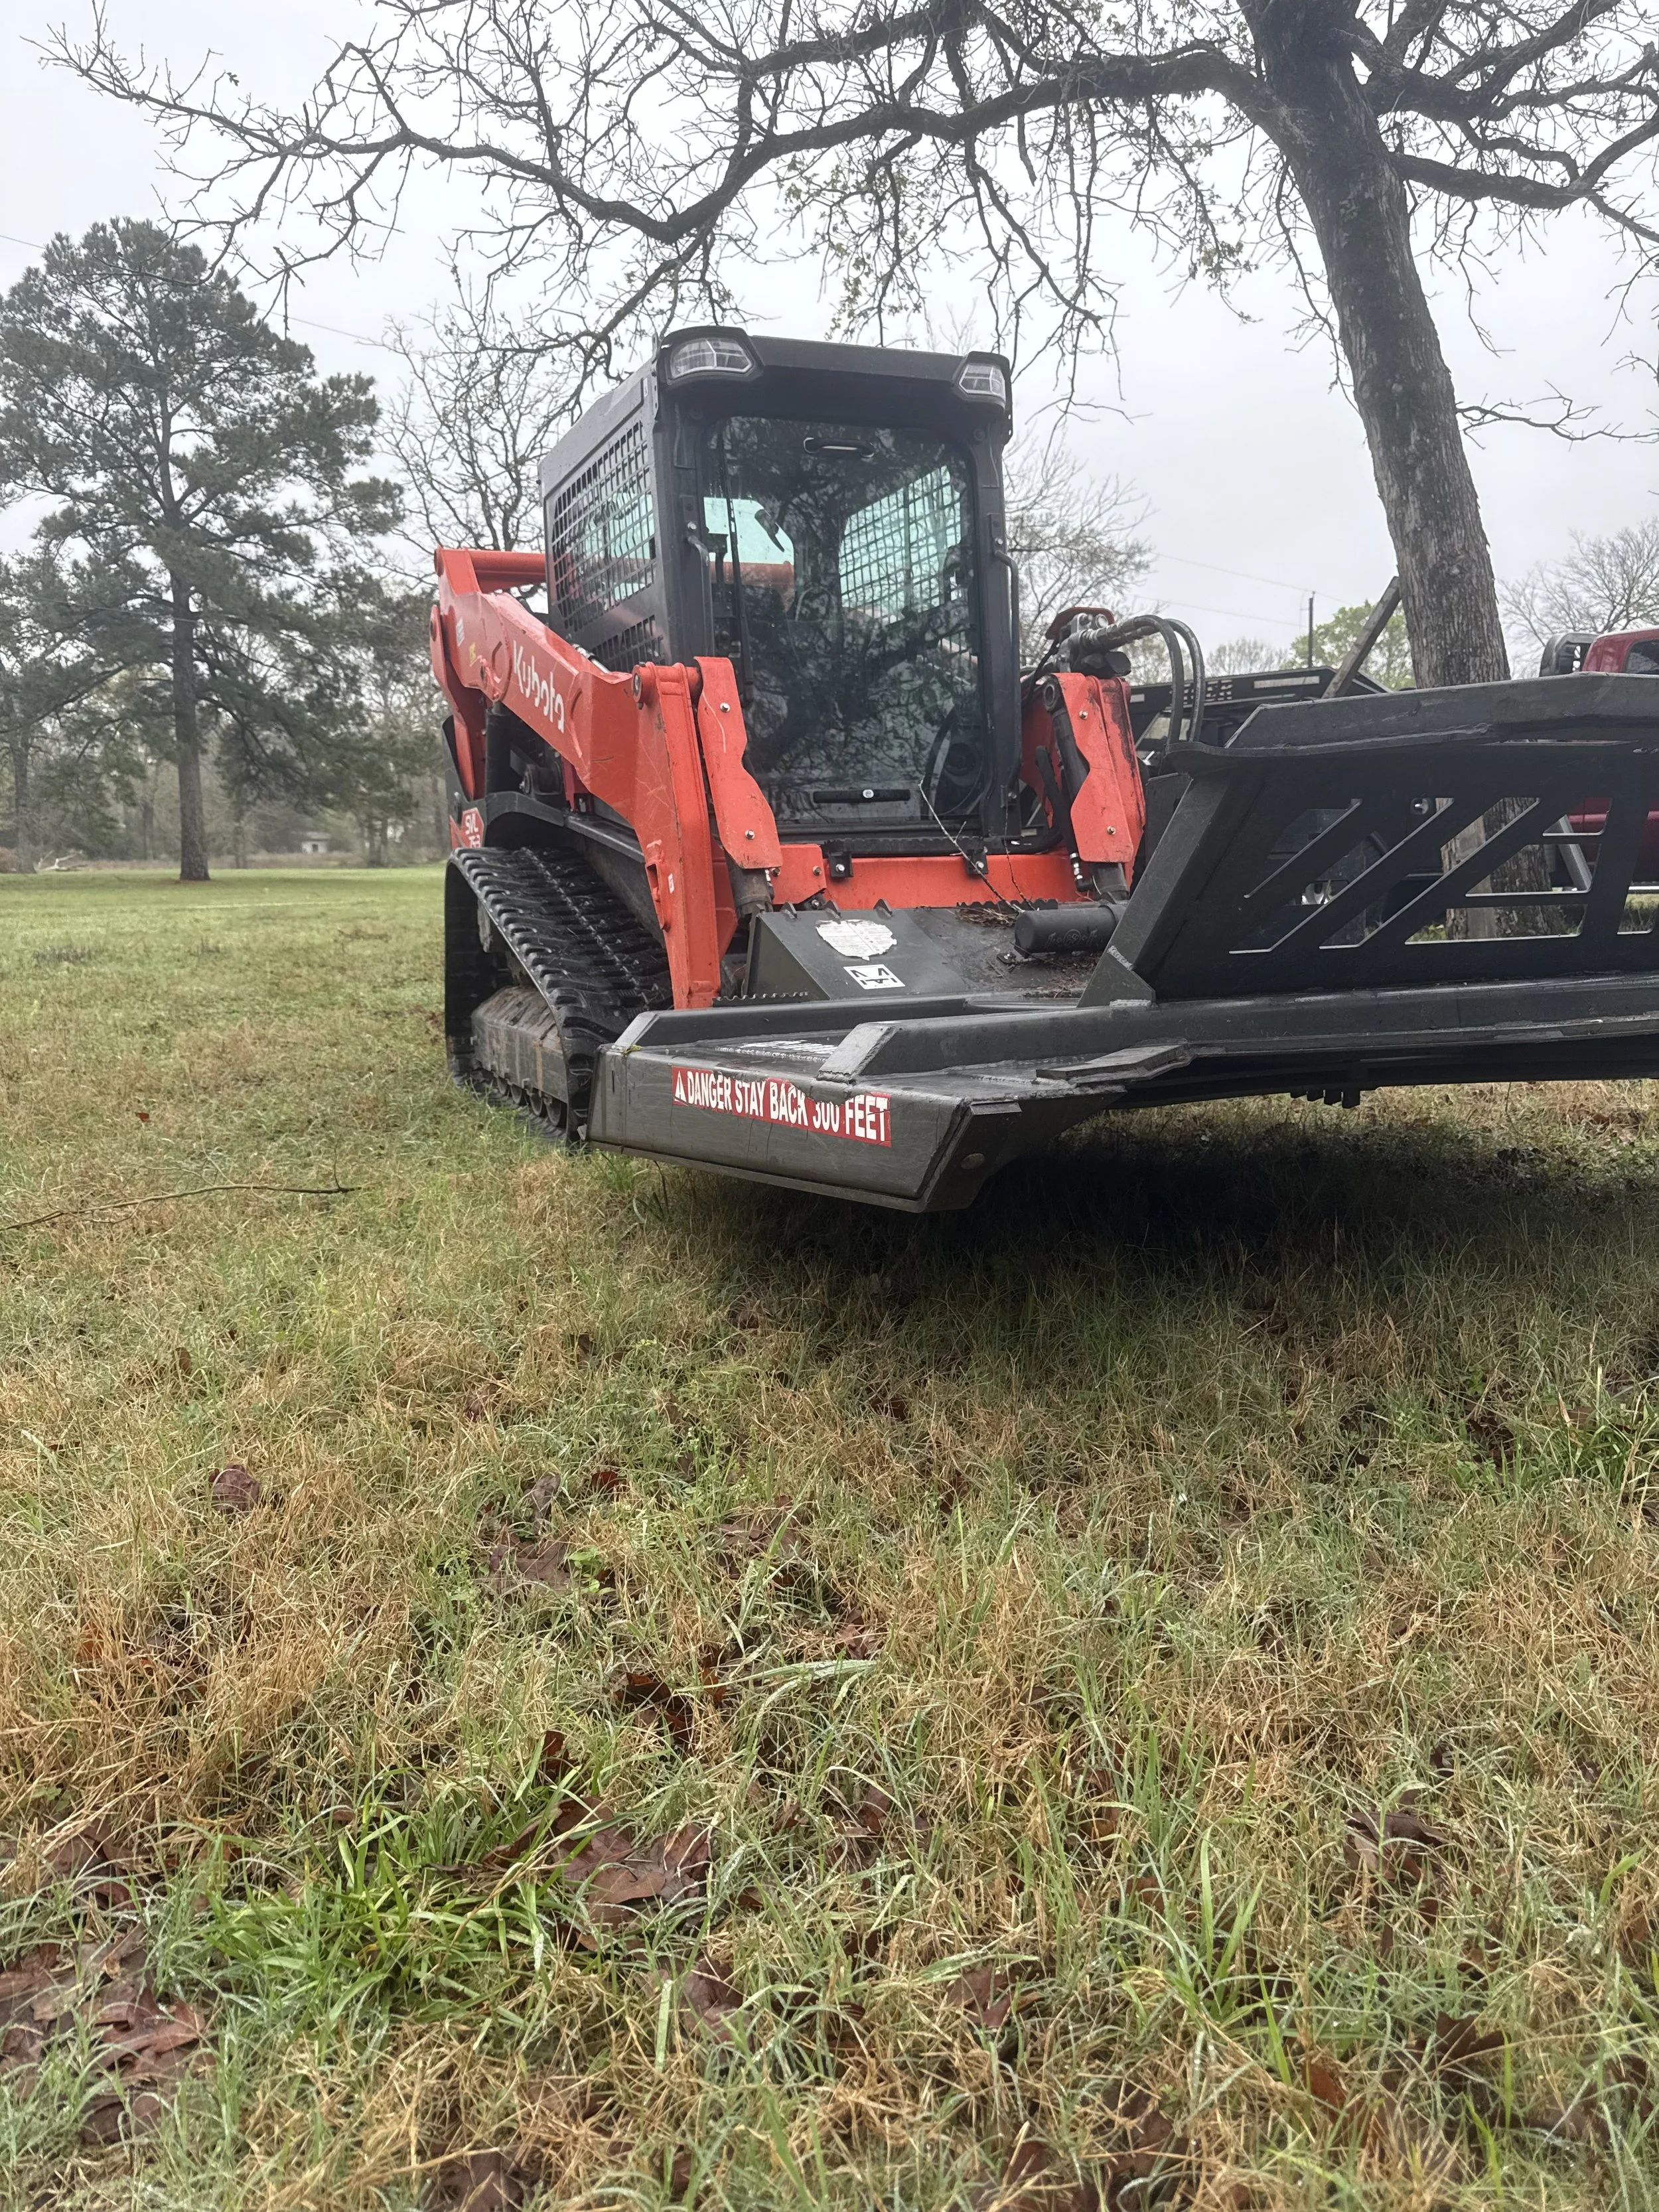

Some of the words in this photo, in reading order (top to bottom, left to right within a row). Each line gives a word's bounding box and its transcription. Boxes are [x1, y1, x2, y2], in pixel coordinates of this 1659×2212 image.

[513, 640, 564, 734] Kubota
[465, 813, 478, 835] SVL
[687, 1070, 732, 1111] DANGER
[735, 1079, 766, 1117] STAY
[770, 1081, 808, 1126] BACK
[812, 1101, 840, 1133] 300
[845, 1094, 888, 1142] FEET
